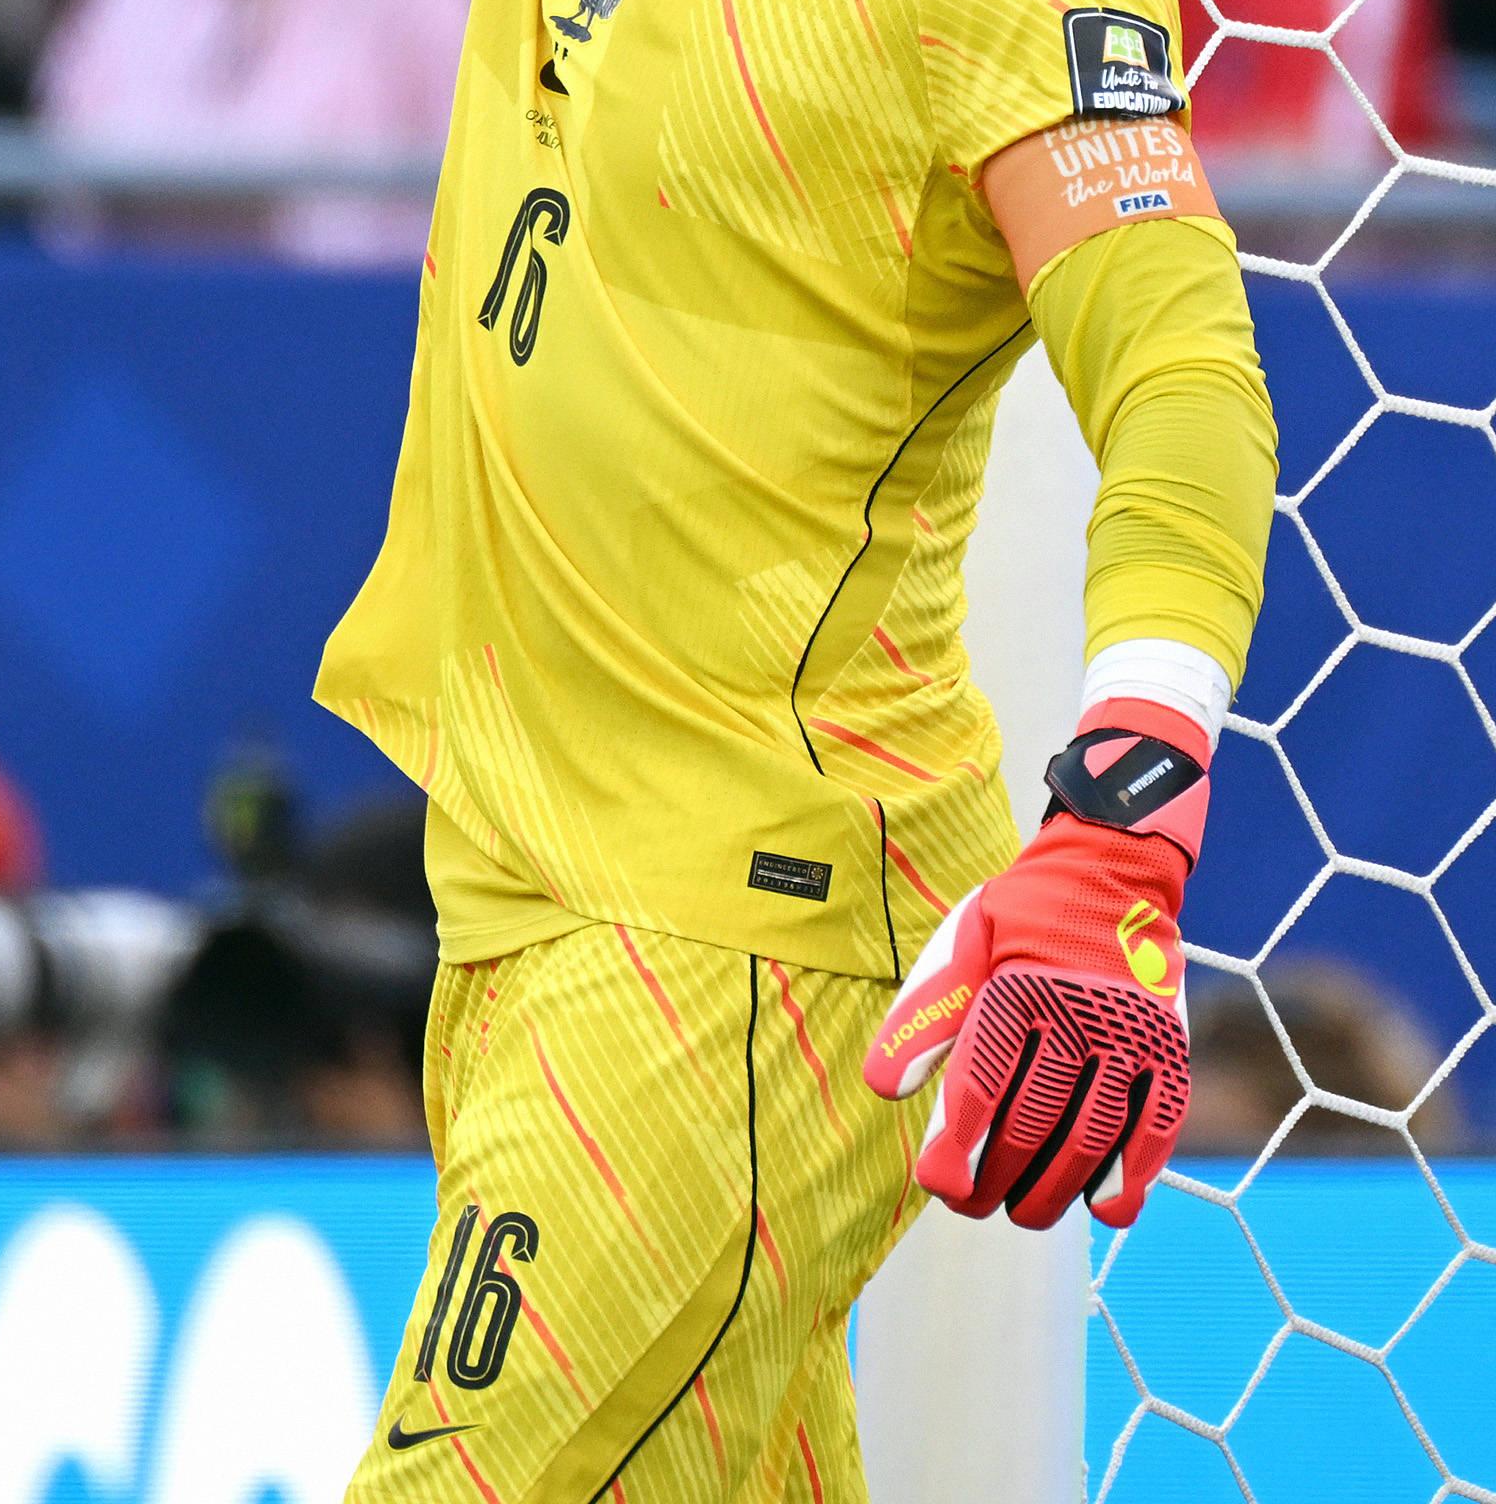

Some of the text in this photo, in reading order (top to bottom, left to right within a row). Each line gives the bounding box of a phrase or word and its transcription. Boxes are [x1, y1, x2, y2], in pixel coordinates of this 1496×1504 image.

[1093, 91, 1171, 114] EDUCATION
[1101, 66, 1141, 90] Unite
[1050, 125, 1183, 177] UNITES
[1060, 157, 1197, 208] the World
[1119, 193, 1169, 213] FIFA
[477, 186, 570, 367] 16
[880, 984, 973, 1058] uhlsport
[413, 1204, 540, 1391] 16
